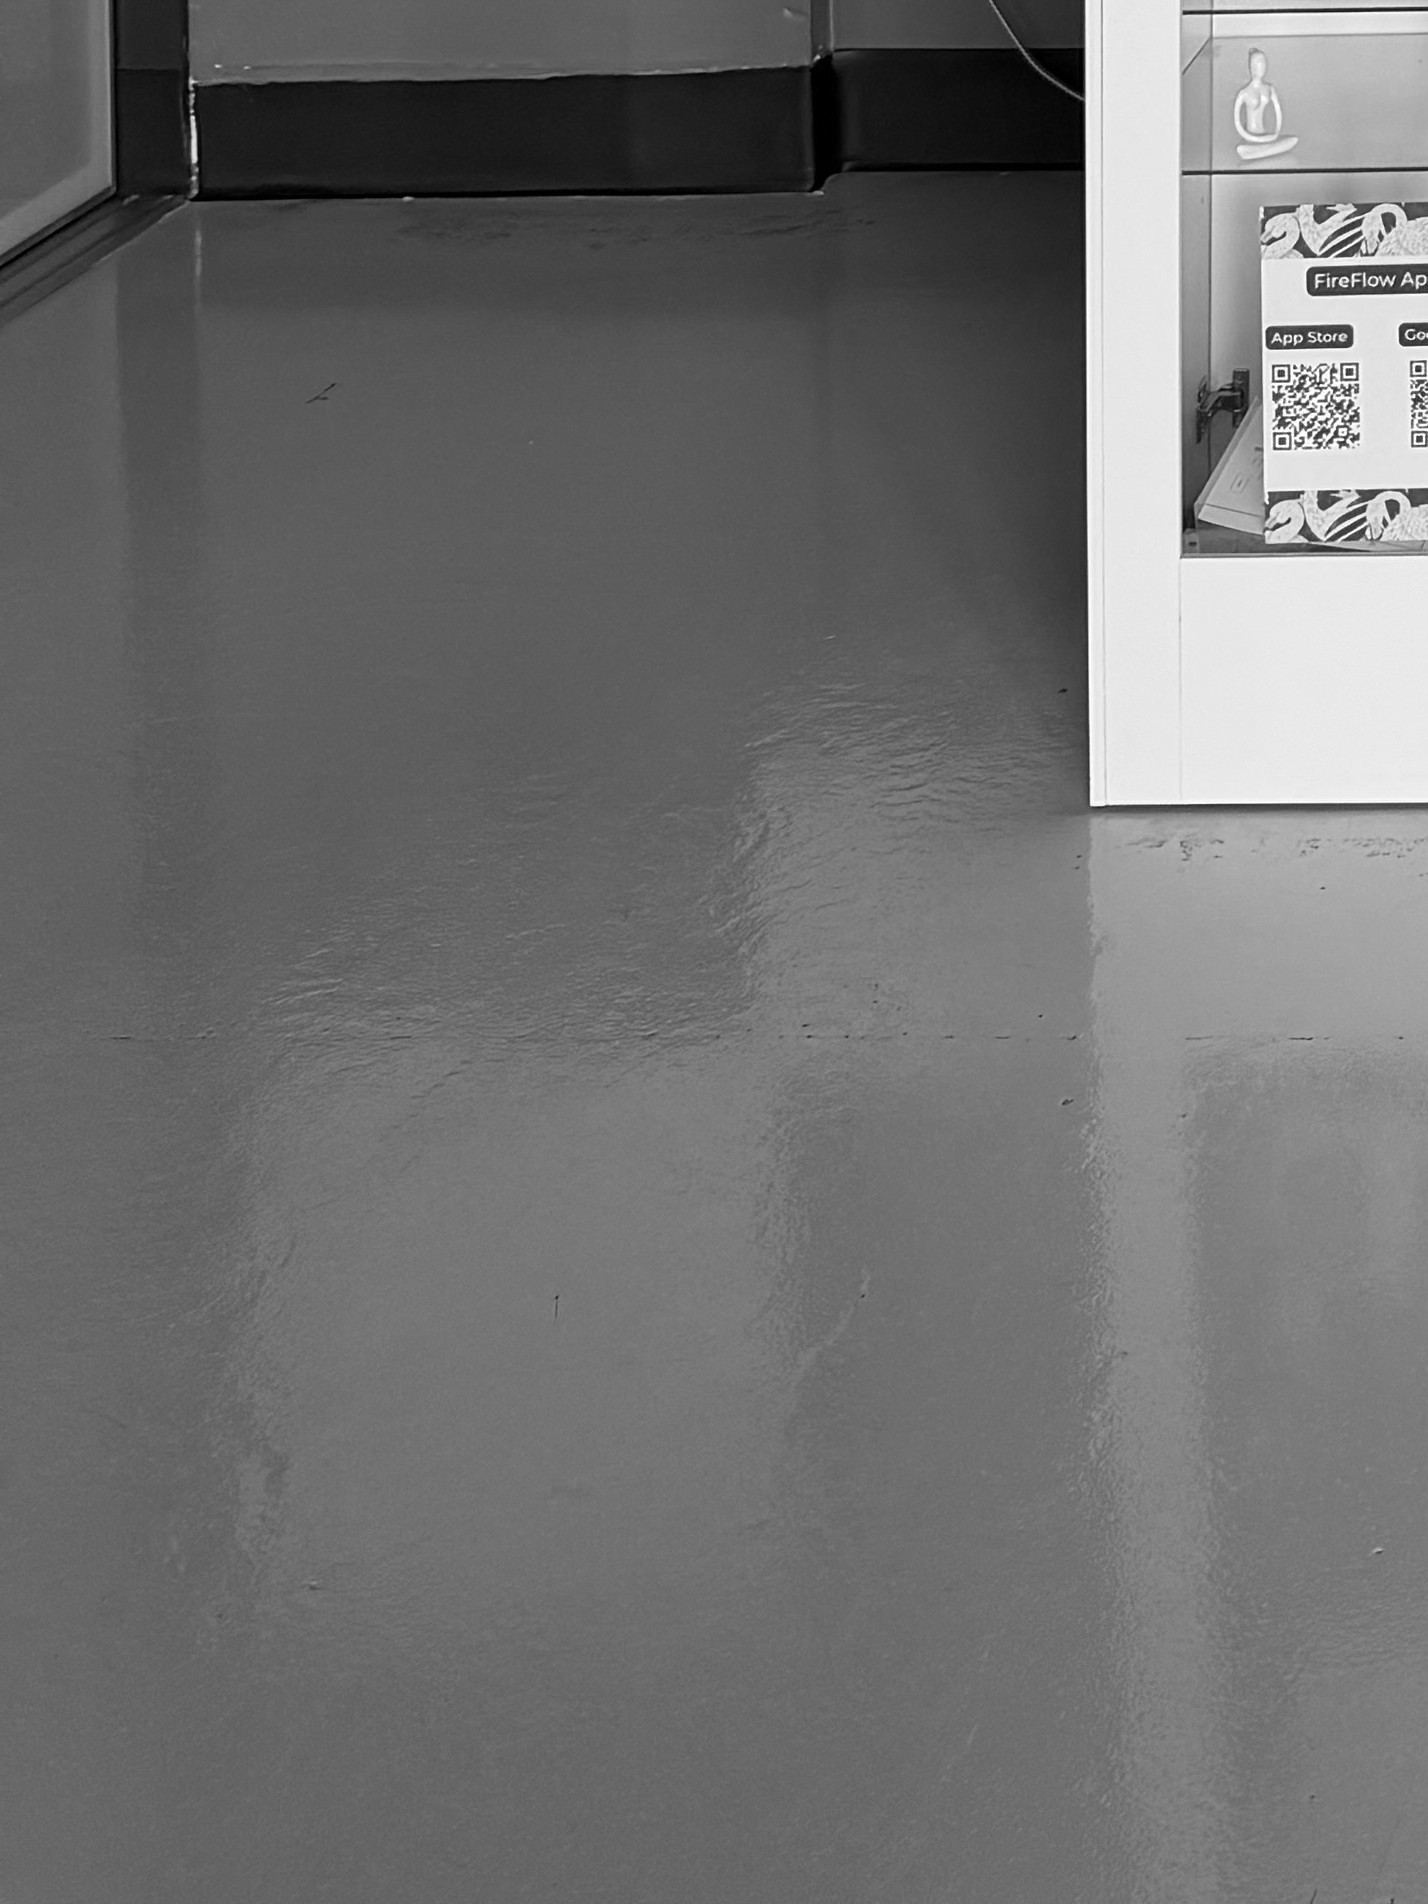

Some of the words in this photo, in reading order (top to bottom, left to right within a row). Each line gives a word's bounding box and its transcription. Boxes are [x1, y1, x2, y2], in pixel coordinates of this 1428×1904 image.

[1314, 272, 1396, 290] FireFlow
[1271, 331, 1304, 345] App
[1308, 329, 1348, 343] Store
